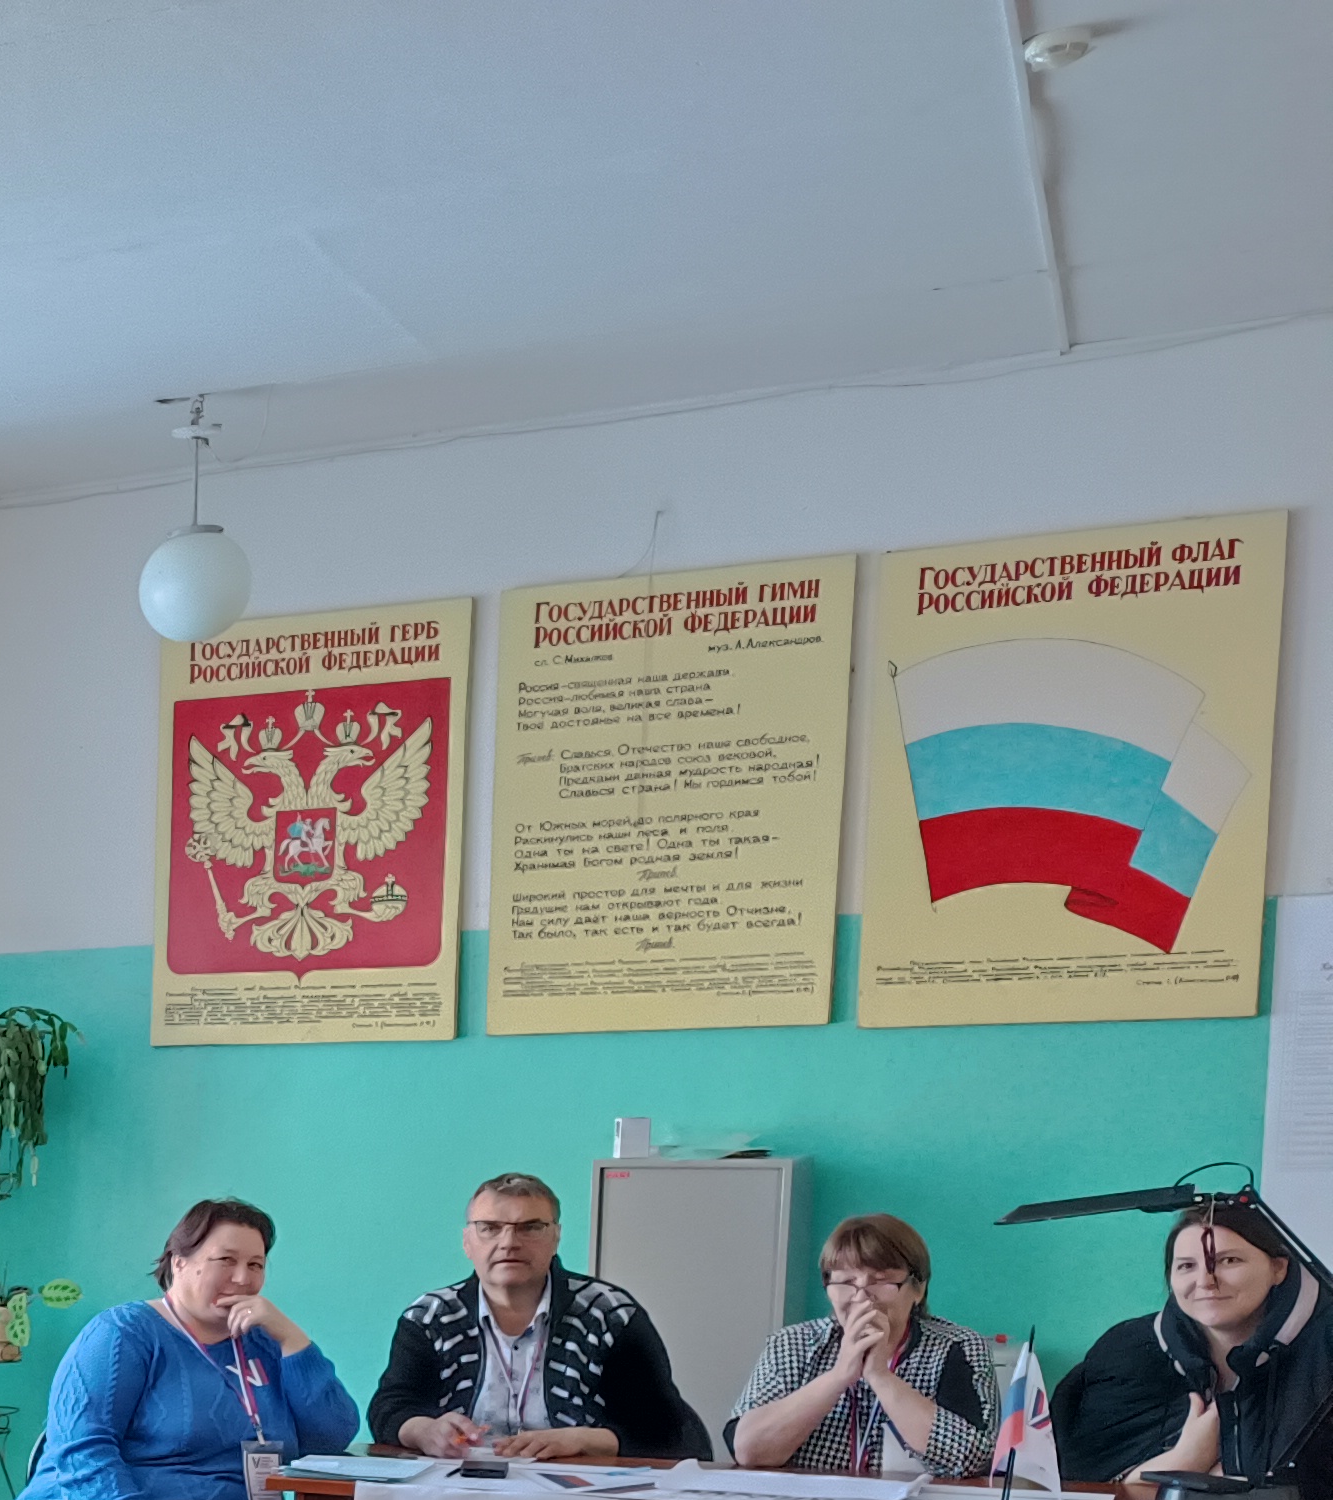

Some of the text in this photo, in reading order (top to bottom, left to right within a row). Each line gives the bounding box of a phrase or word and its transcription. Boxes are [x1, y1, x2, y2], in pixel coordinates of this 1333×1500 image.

[918, 538, 1244, 591] ГОСУДАРСТВЕННЫЙ ФЛАГ
[534, 578, 821, 624] ГОСУДАРСТВЕННЫЙ ГИМН
[917, 564, 1241, 616] РОССИЙСКОЙ ФЕДЕРАЦИИ
[189, 620, 440, 662] ГОСУДАРСТВЕННЫЙ ГЕРБ
[533, 603, 817, 648] РОССИЙСКОЙ ФЕДЕРАЦИИ
[189, 643, 441, 684] РОССИЙСКОЙ ФЕДЕРАЦИИ
[665, 682, 711, 695] страна
[626, 714, 642, 722] на
[515, 822, 532, 833] От
[728, 808, 759, 820] края
[679, 827, 687, 835] и
[701, 837, 720, 847] ты
[712, 883, 720, 891] и
